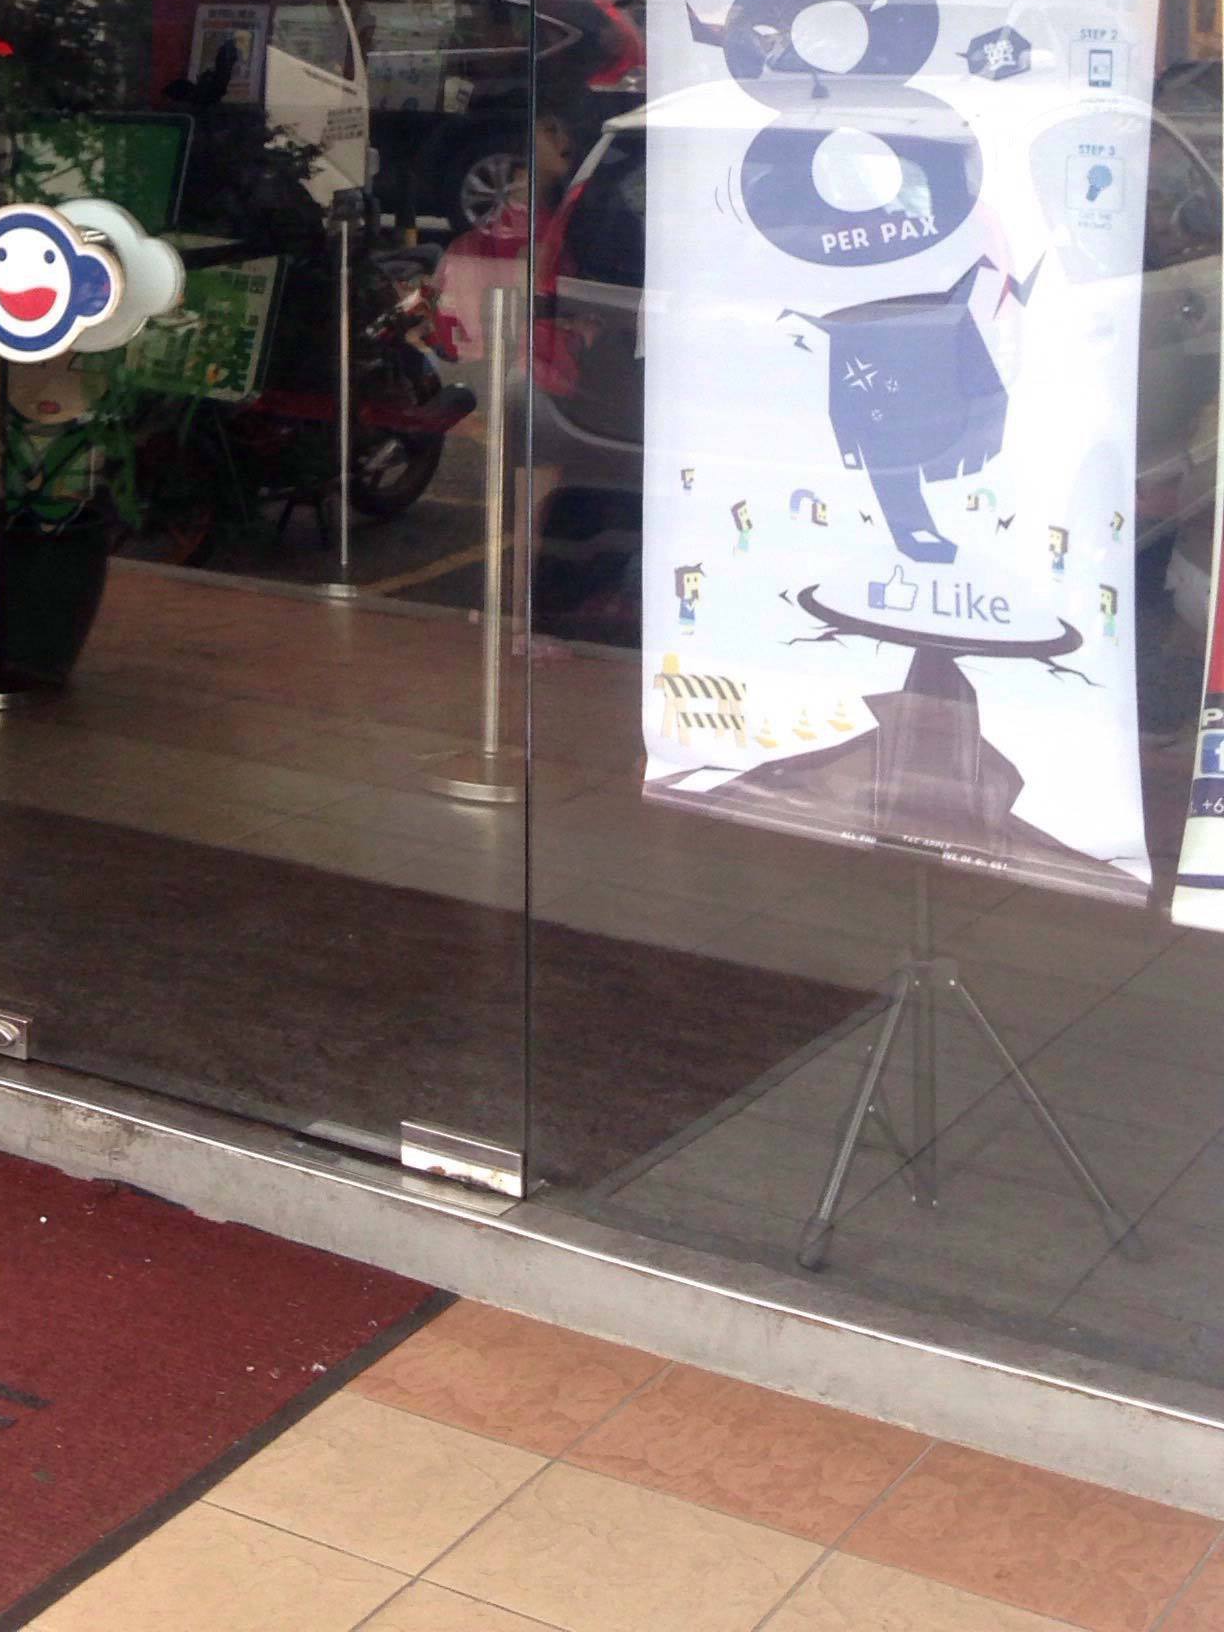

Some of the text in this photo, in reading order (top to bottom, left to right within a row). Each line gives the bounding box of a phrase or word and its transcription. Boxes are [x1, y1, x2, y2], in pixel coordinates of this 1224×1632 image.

[1078, 144, 1105, 156] STEP
[821, 214, 939, 255] PER PAX
[932, 579, 1012, 625] Like
